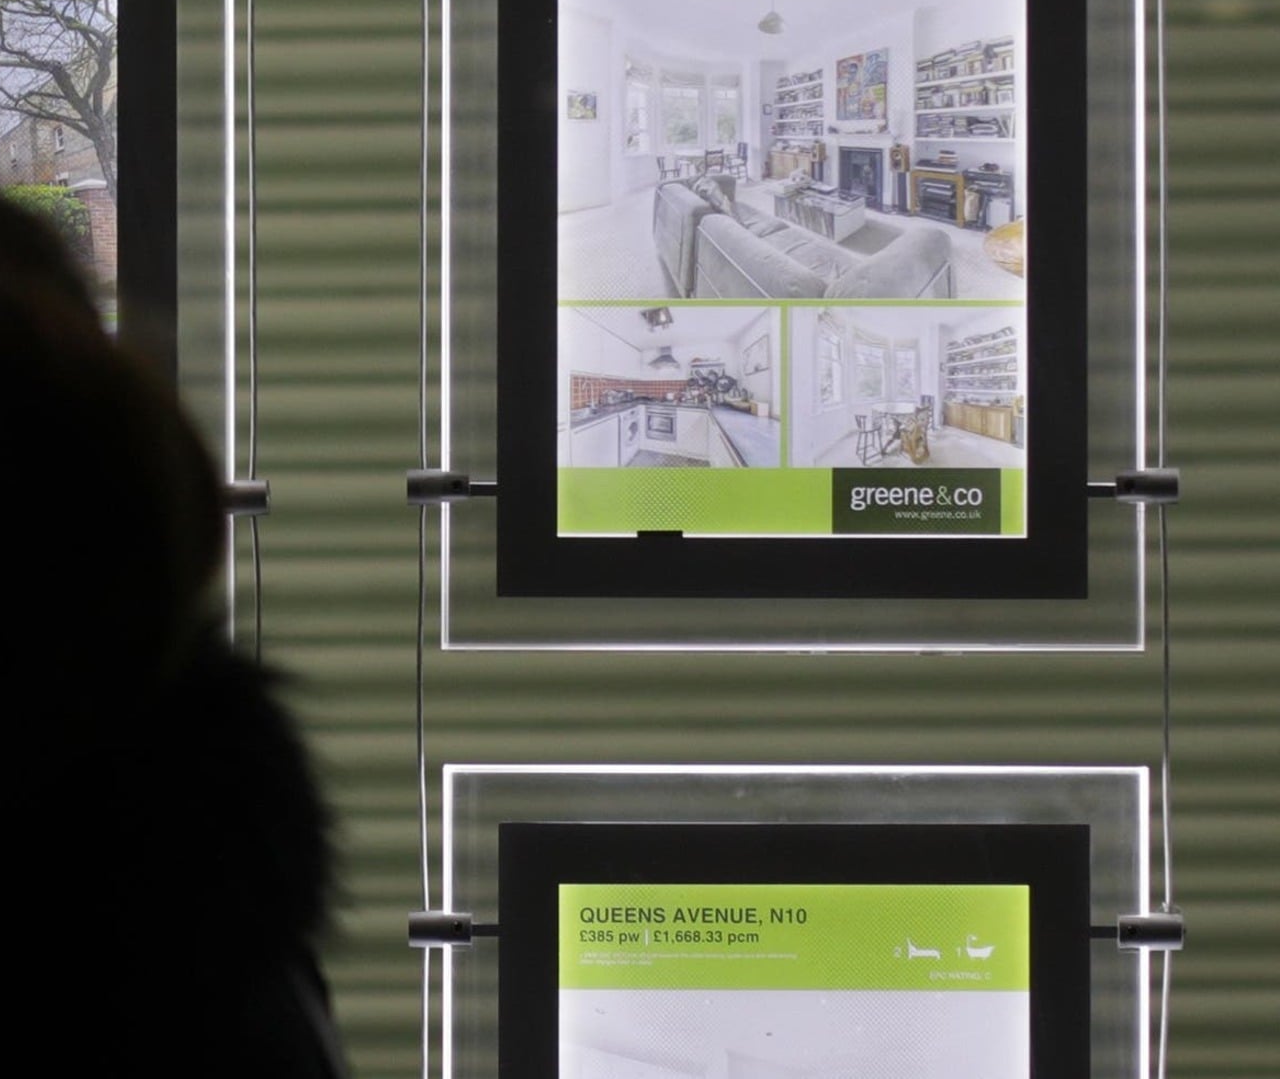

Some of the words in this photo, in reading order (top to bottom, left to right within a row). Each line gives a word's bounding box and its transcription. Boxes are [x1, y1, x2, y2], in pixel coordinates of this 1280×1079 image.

[579, 907, 666, 924] QUEENS
[672, 907, 763, 926] AVENUE,
[770, 908, 808, 925] N10
[579, 930, 614, 943] £385
[618, 932, 640, 945] pw
[653, 930, 723, 944] £1,668.33
[727, 932, 760, 945] pcm
